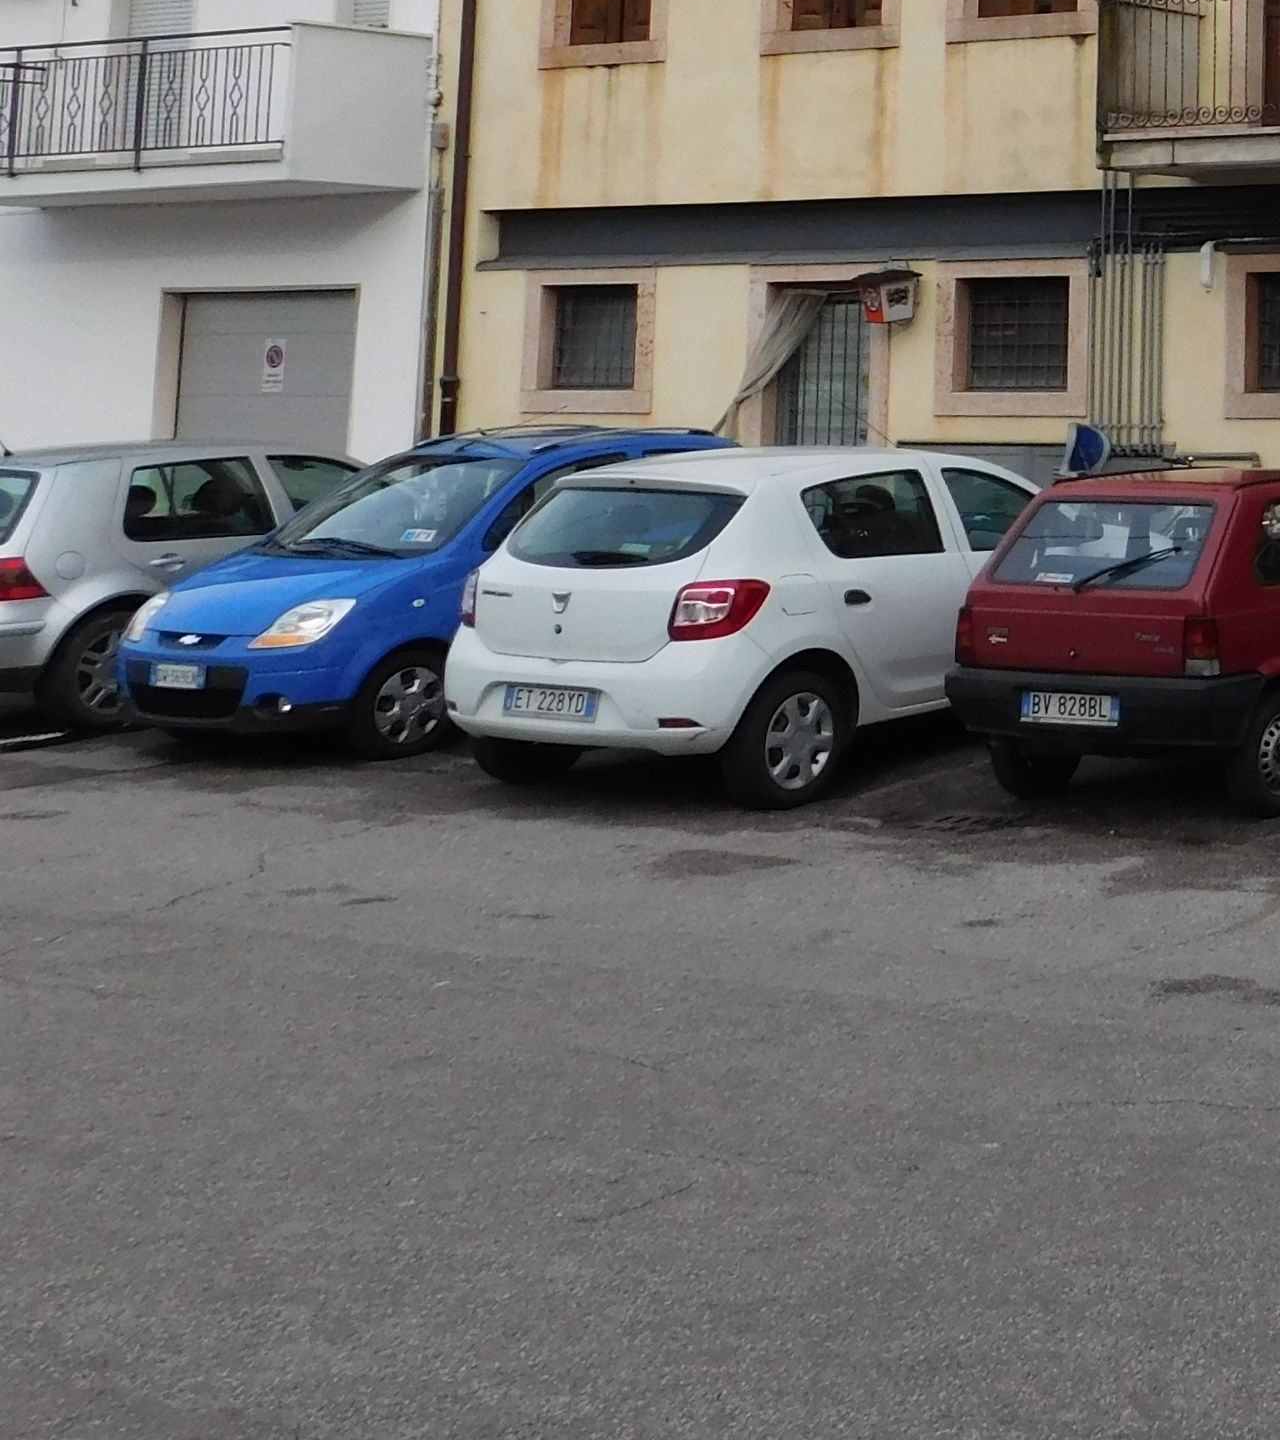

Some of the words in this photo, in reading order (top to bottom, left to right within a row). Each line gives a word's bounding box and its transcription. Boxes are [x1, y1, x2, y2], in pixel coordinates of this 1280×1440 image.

[514, 688, 534, 709] ET
[537, 690, 585, 713] 228YD
[1031, 694, 1052, 715] BV
[1058, 696, 1108, 718] 828BL
